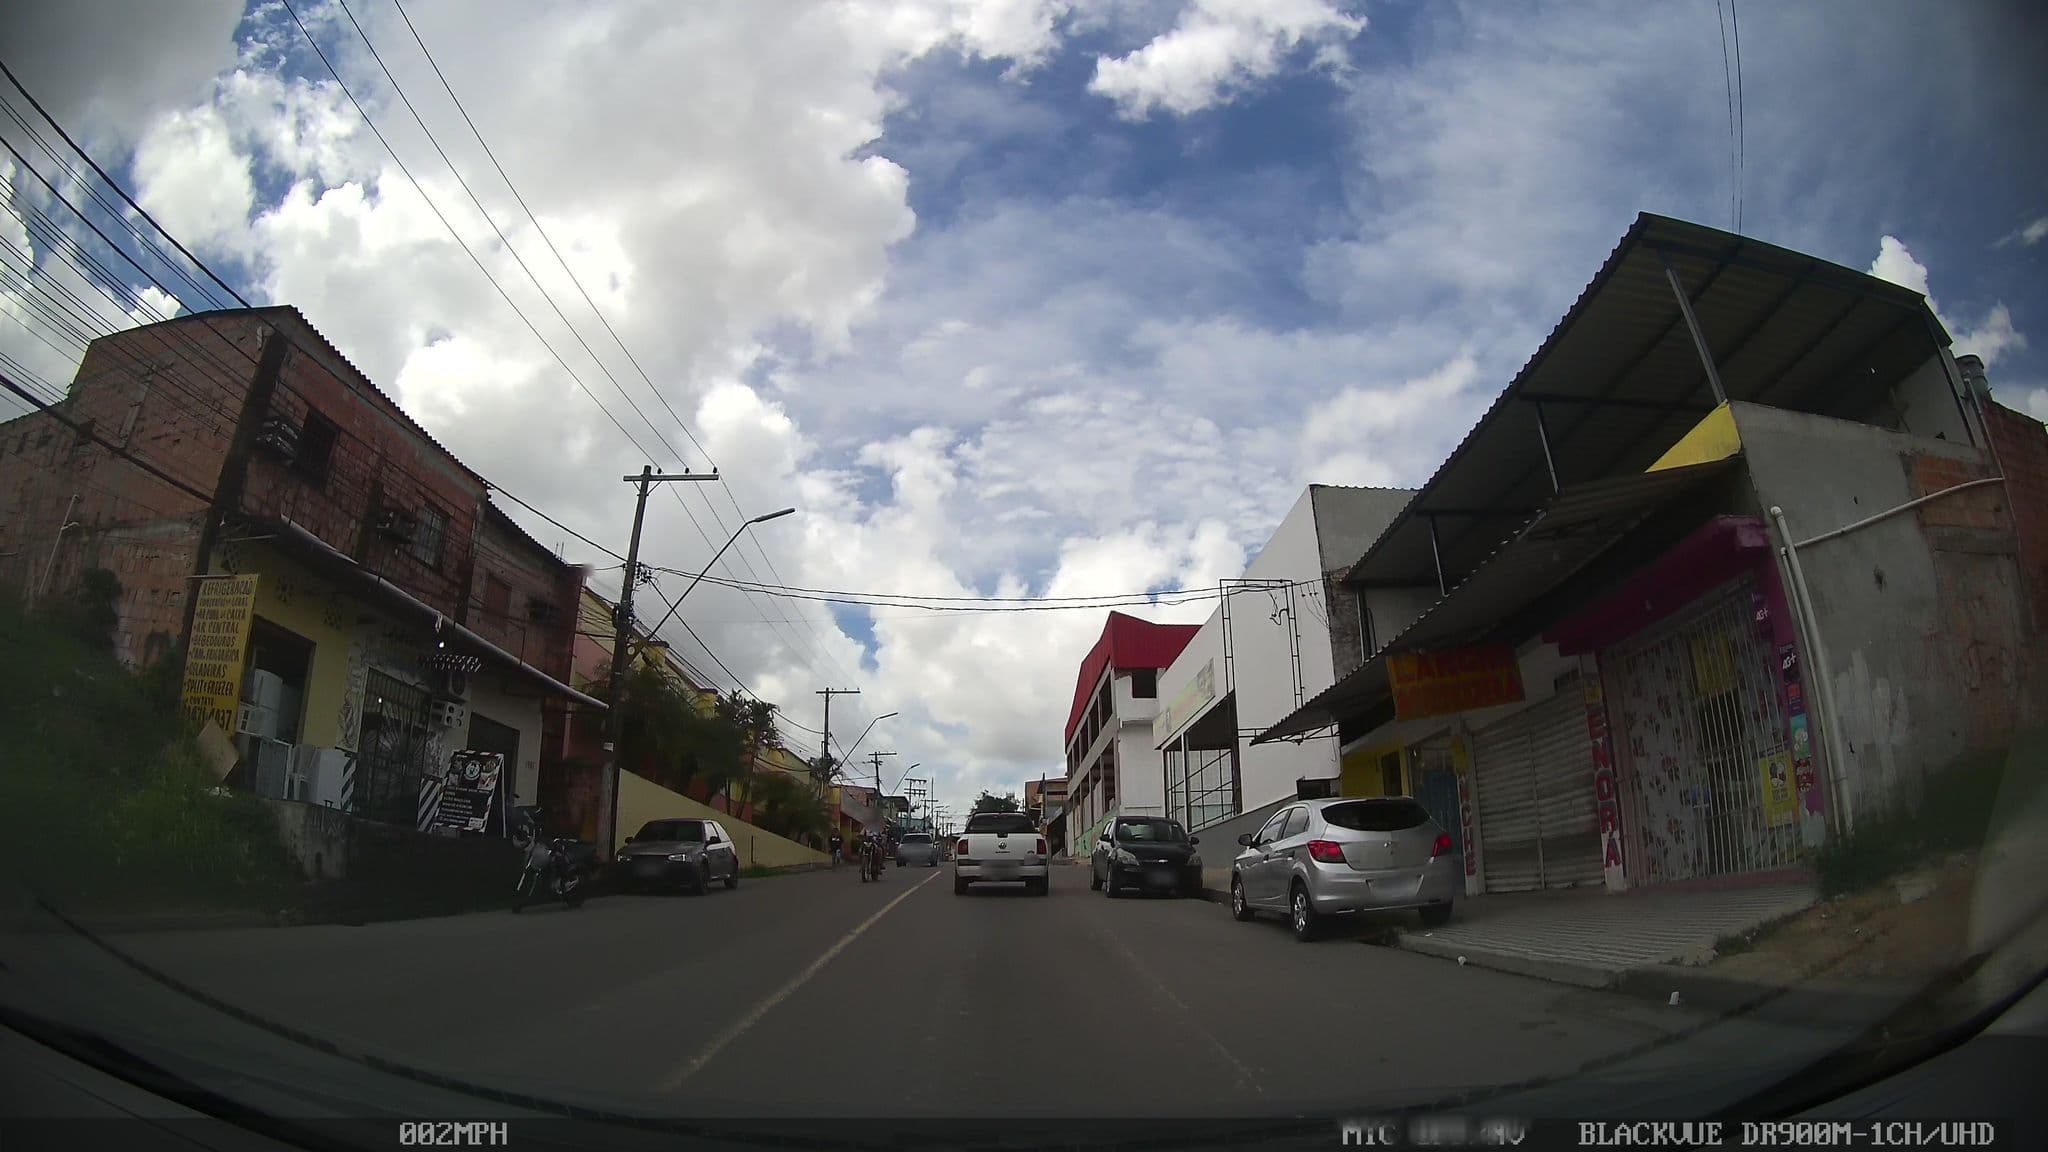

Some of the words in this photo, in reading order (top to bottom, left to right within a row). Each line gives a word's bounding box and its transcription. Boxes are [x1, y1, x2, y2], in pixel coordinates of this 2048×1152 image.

[208, 622, 239, 634] CENTRAL
[193, 634, 236, 647] BEBEDOUROS
[1782, 652, 1796, 670] 4G+
[189, 662, 227, 678] GELADEIRAS
[207, 680, 234, 696] FREEZER
